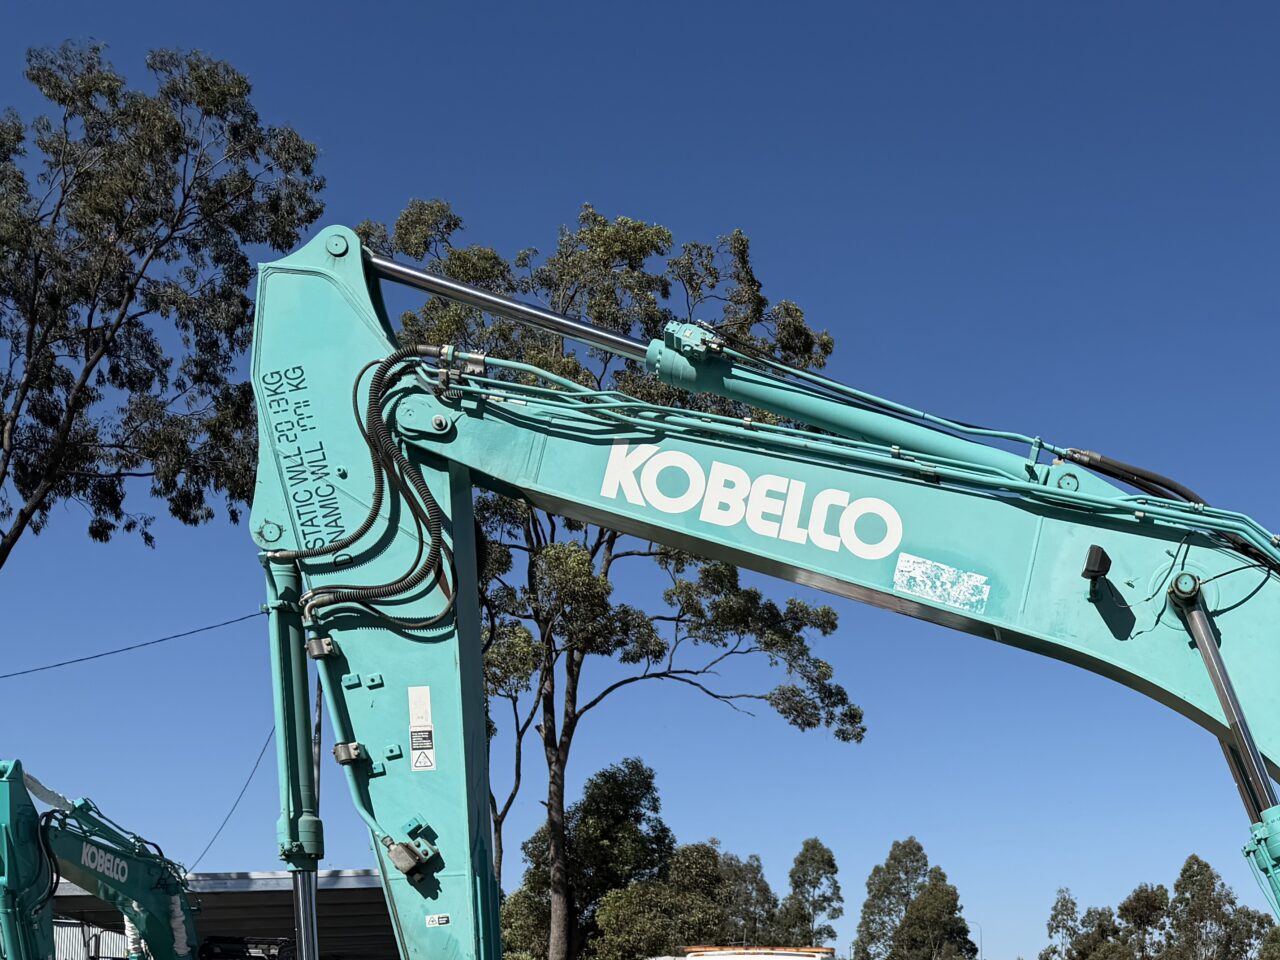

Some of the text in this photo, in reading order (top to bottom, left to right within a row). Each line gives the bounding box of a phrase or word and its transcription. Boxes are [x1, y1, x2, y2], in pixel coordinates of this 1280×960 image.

[284, 365, 307, 392] KG
[283, 446, 308, 487] WLL
[305, 441, 330, 482] WLL
[600, 437, 903, 560] KOBELCO
[293, 489, 325, 551] STATIC
[81, 841, 128, 883] KOBELCO
